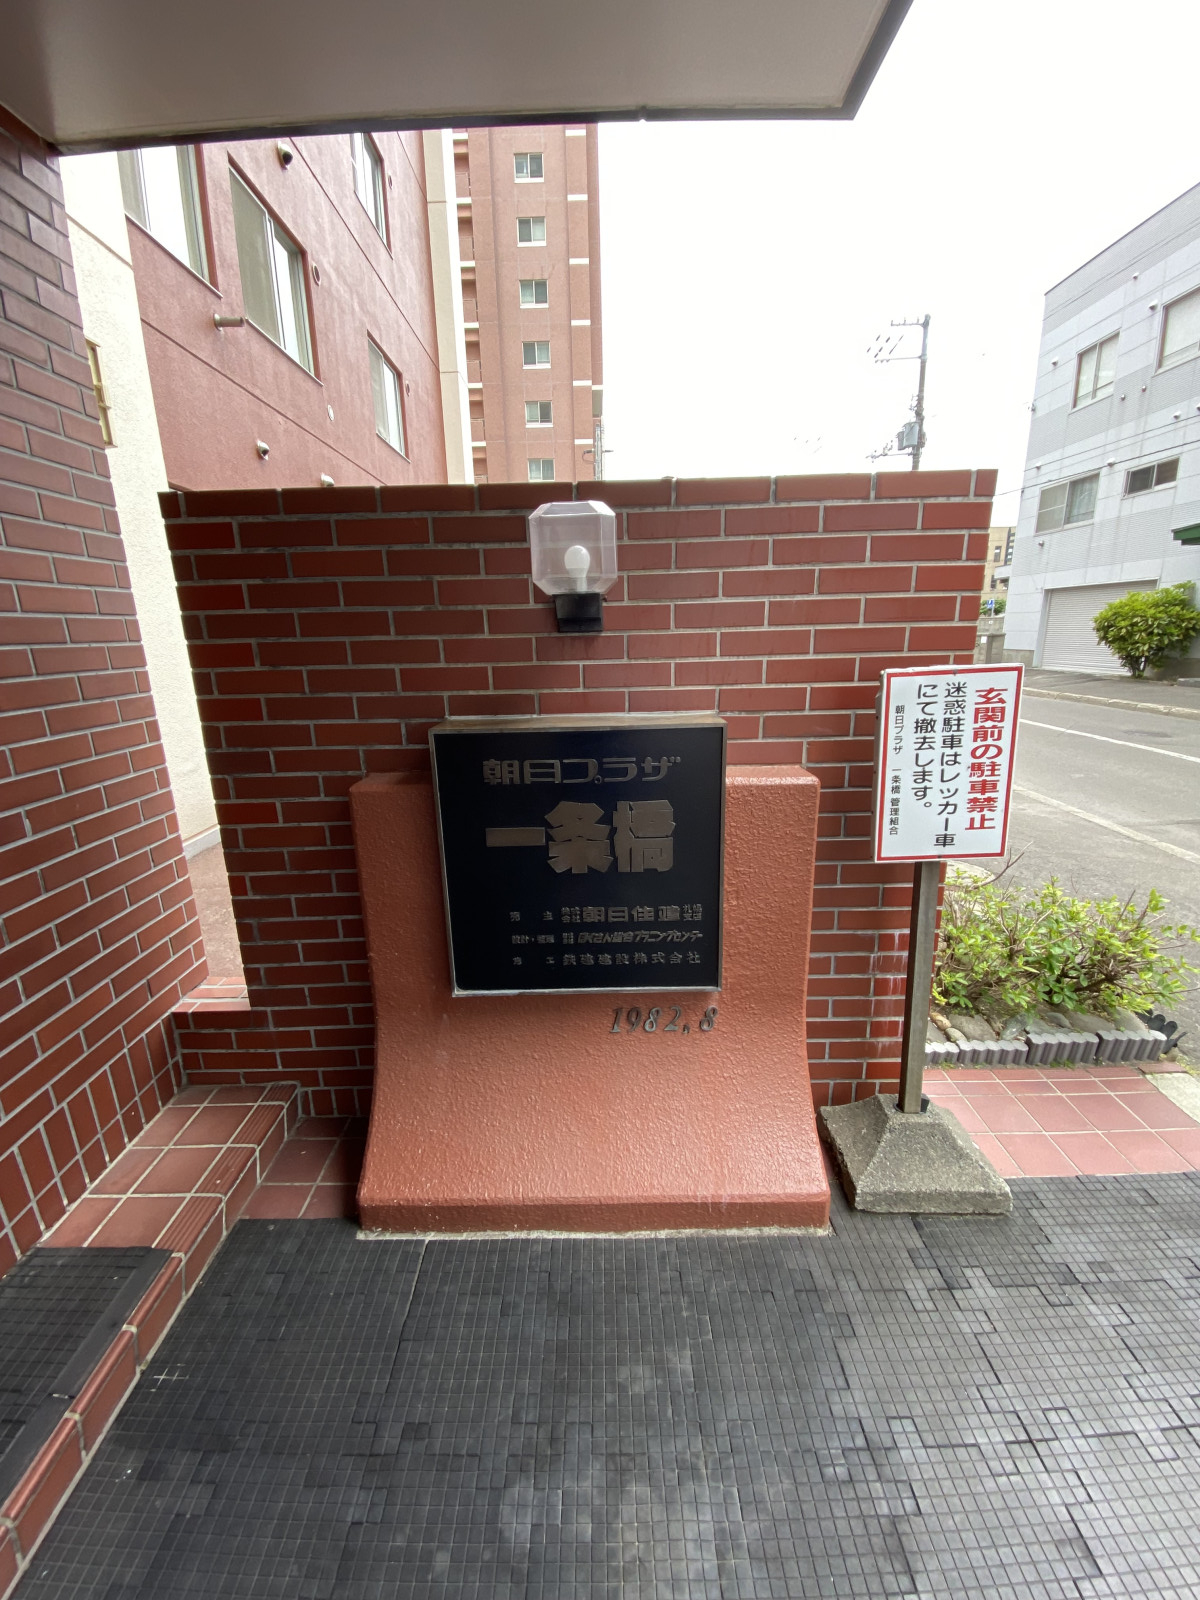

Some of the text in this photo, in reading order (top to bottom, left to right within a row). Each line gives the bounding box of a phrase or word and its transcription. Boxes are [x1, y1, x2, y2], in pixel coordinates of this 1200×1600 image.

[483, 756, 682, 785] 朝日プラザ
[911, 683, 939, 809] にて撤去します。
[965, 687, 1008, 831] 玄関前の駐車禁止
[485, 800, 677, 874] 一条橋
